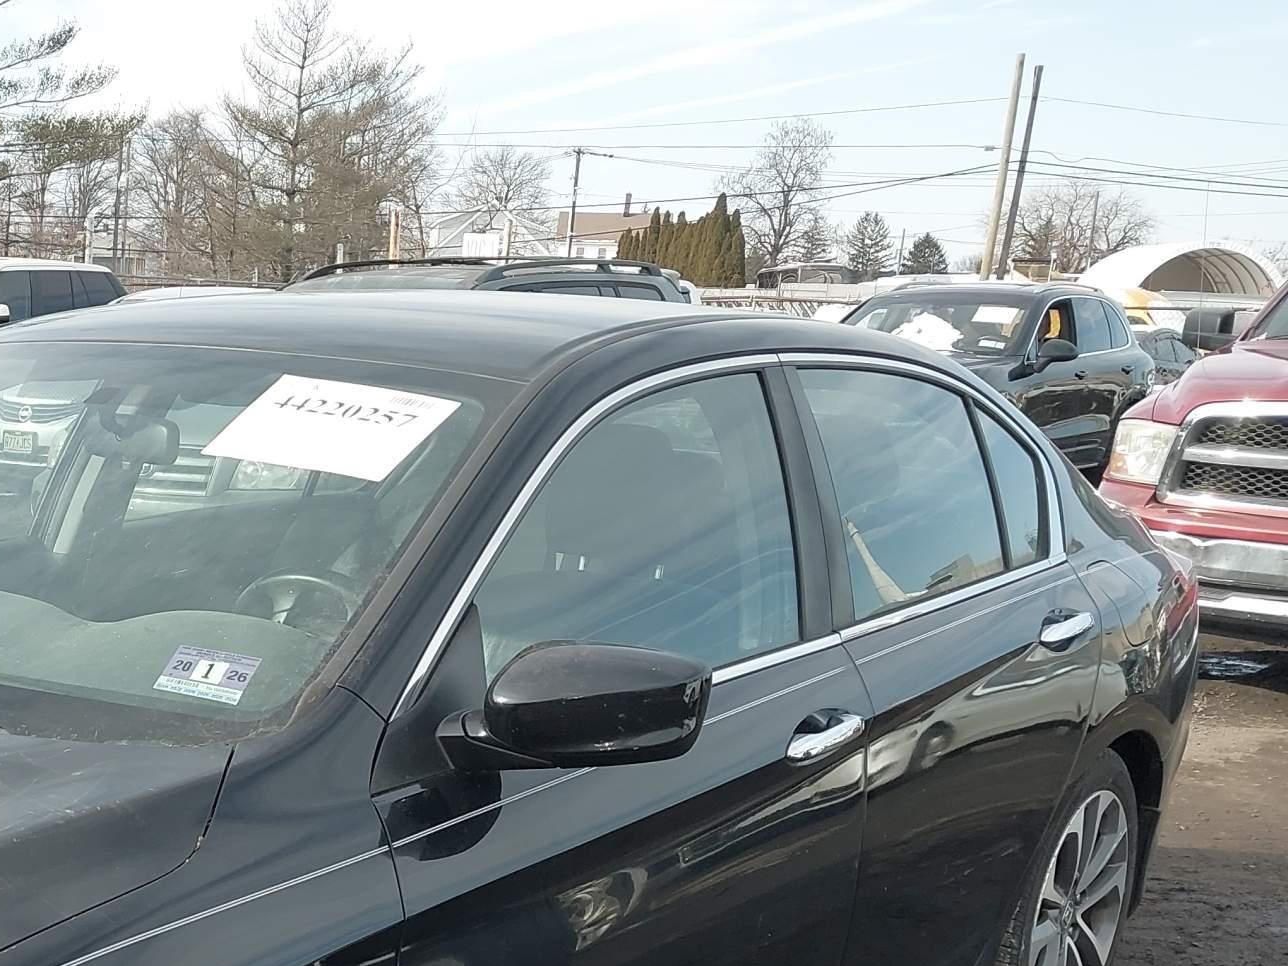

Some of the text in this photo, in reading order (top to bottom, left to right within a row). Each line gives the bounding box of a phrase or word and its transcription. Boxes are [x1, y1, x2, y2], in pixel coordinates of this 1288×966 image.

[274, 395, 419, 427] 44220257
[172, 659, 249, 683] 20 1 26
